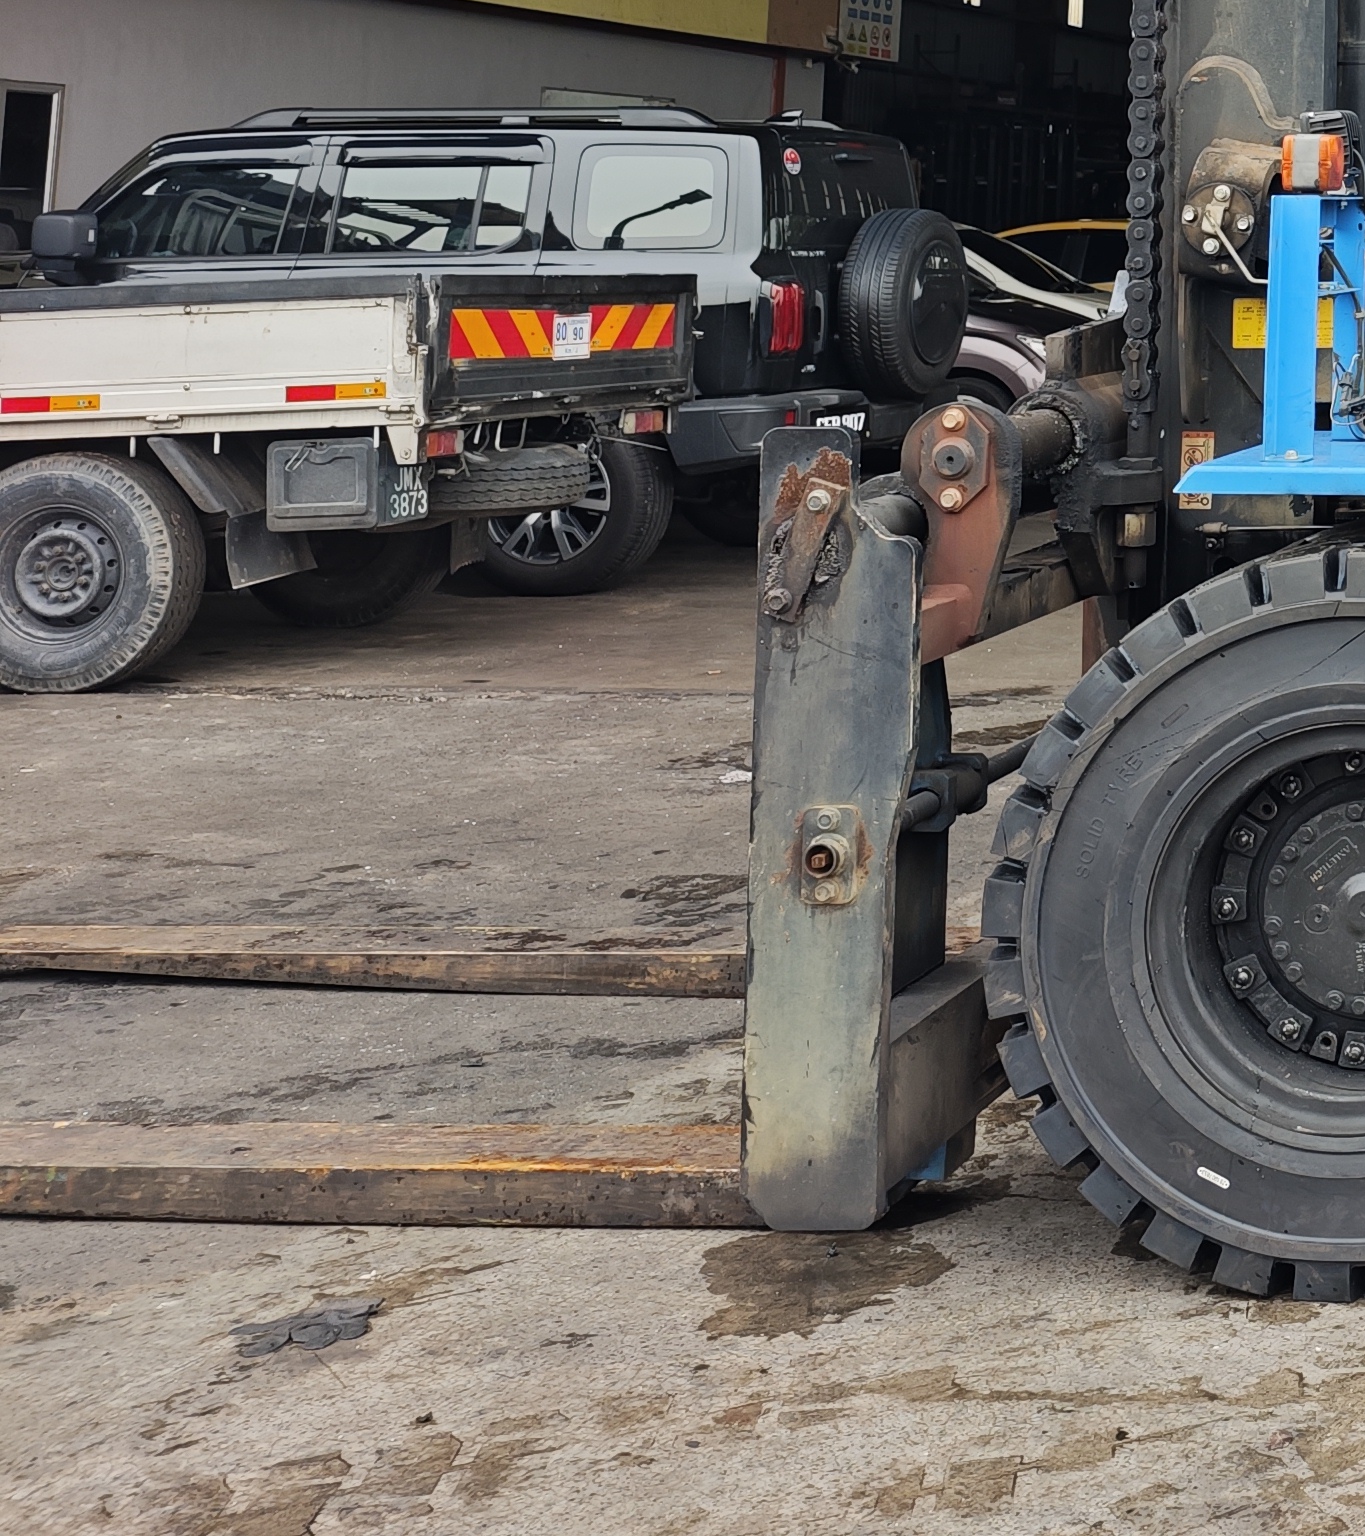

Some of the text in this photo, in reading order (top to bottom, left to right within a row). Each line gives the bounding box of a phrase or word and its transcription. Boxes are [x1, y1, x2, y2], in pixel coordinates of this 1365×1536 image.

[555, 322, 567, 341] 80
[572, 326, 584, 341] 90
[393, 465, 423, 492] JMX
[389, 489, 428, 519] 3873
[1075, 754, 1144, 879] SOLID TYRE
